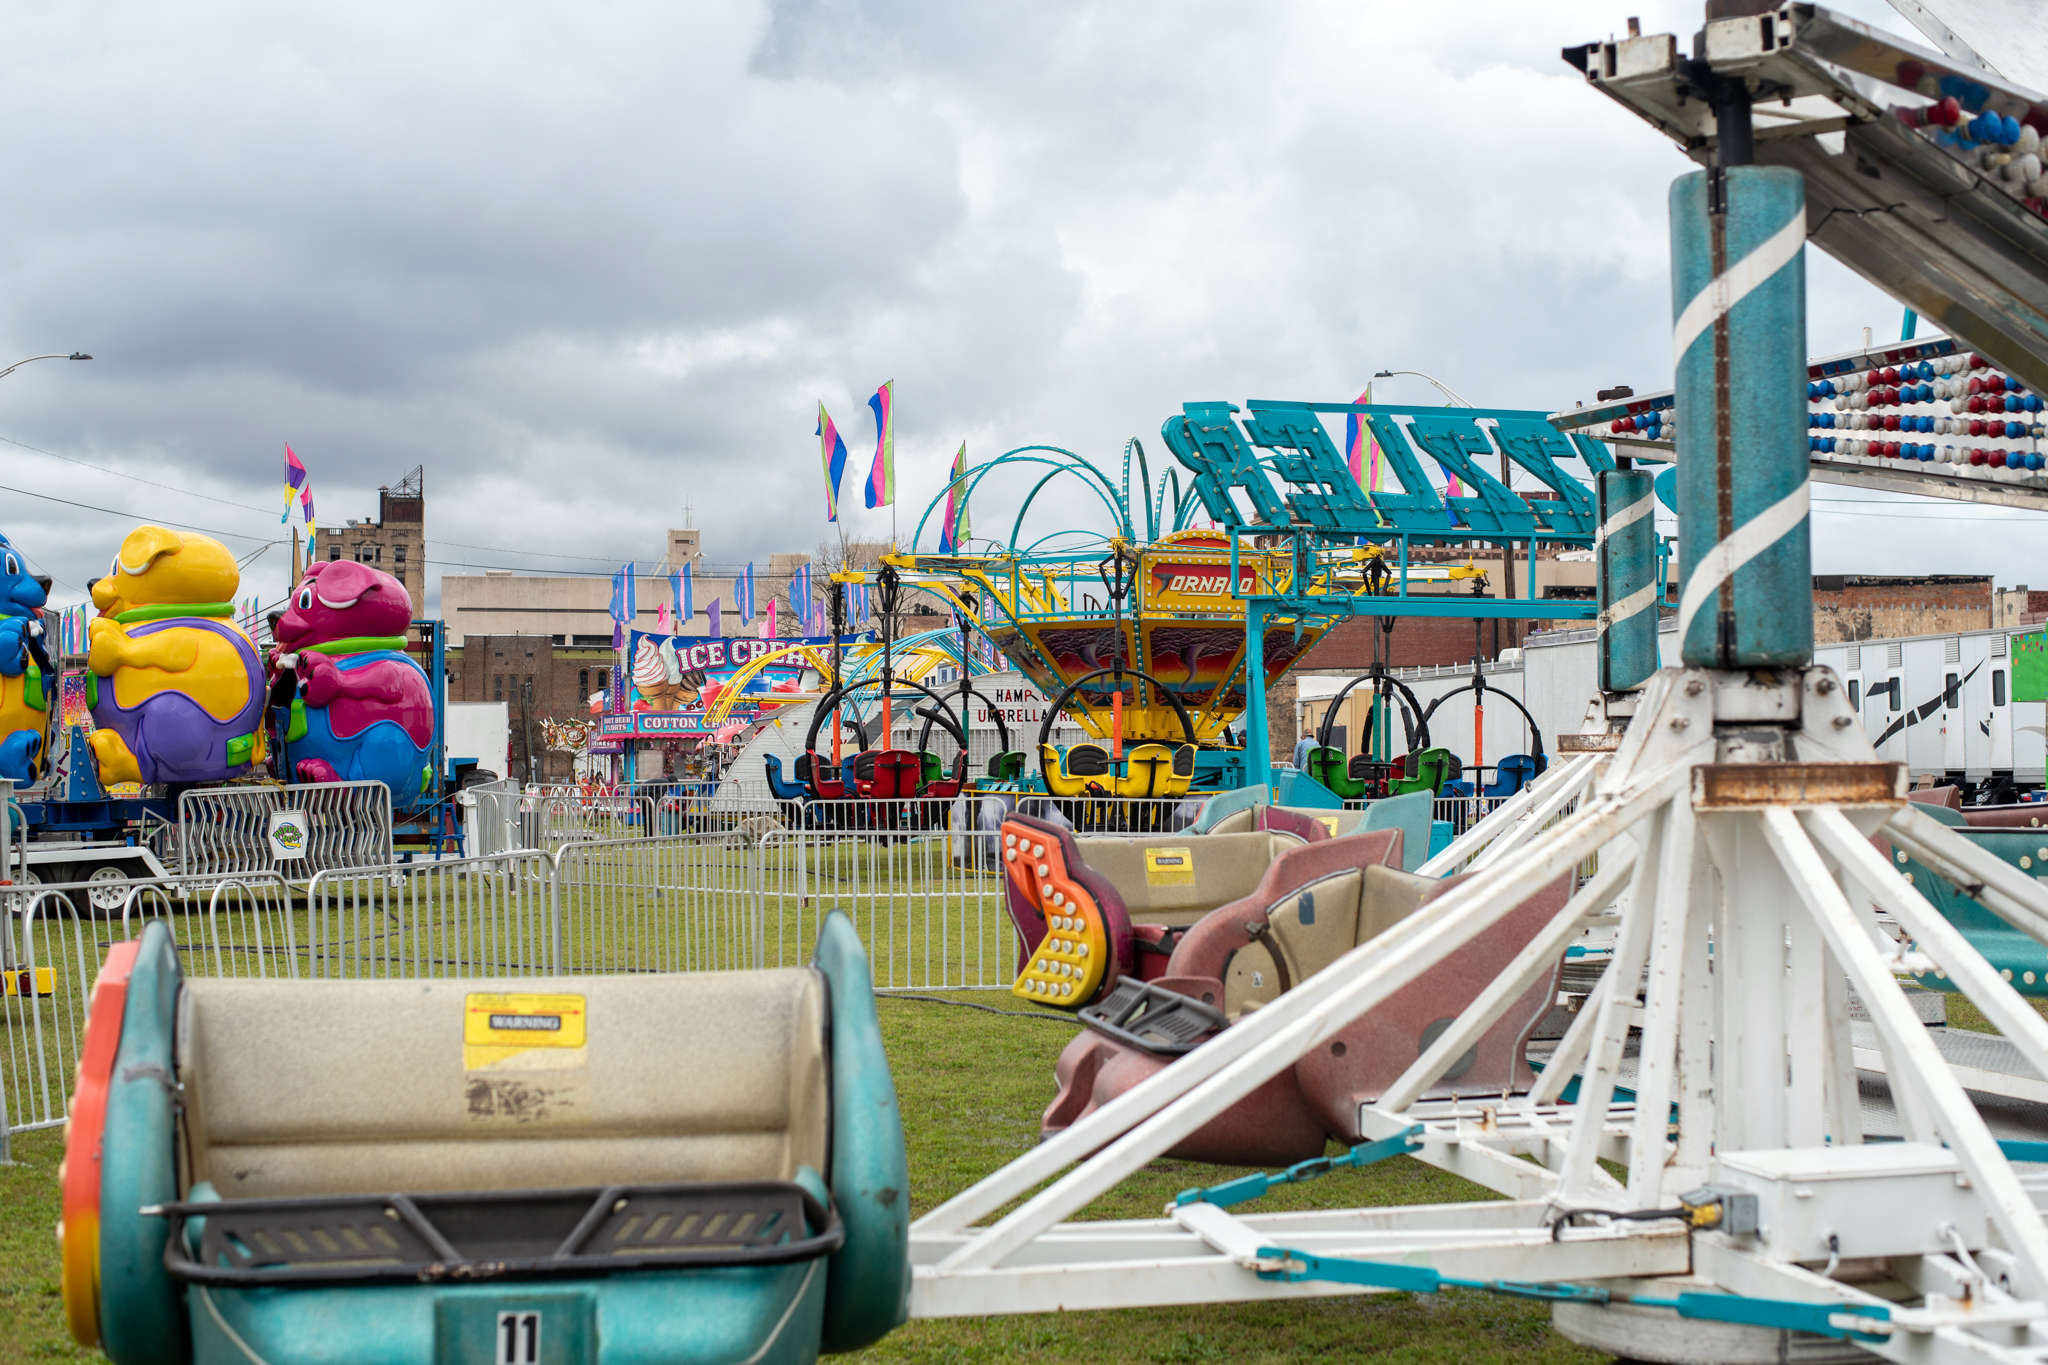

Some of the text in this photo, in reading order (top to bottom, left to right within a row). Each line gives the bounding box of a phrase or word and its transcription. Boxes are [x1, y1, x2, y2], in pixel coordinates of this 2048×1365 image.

[676, 641, 726, 673] ICE
[644, 717, 698, 730] COTTON
[273, 826, 298, 839] PUPPY
[282, 832, 303, 842] ROLL
[491, 1016, 559, 1029] WARNING
[502, 1316, 537, 1362] 11
